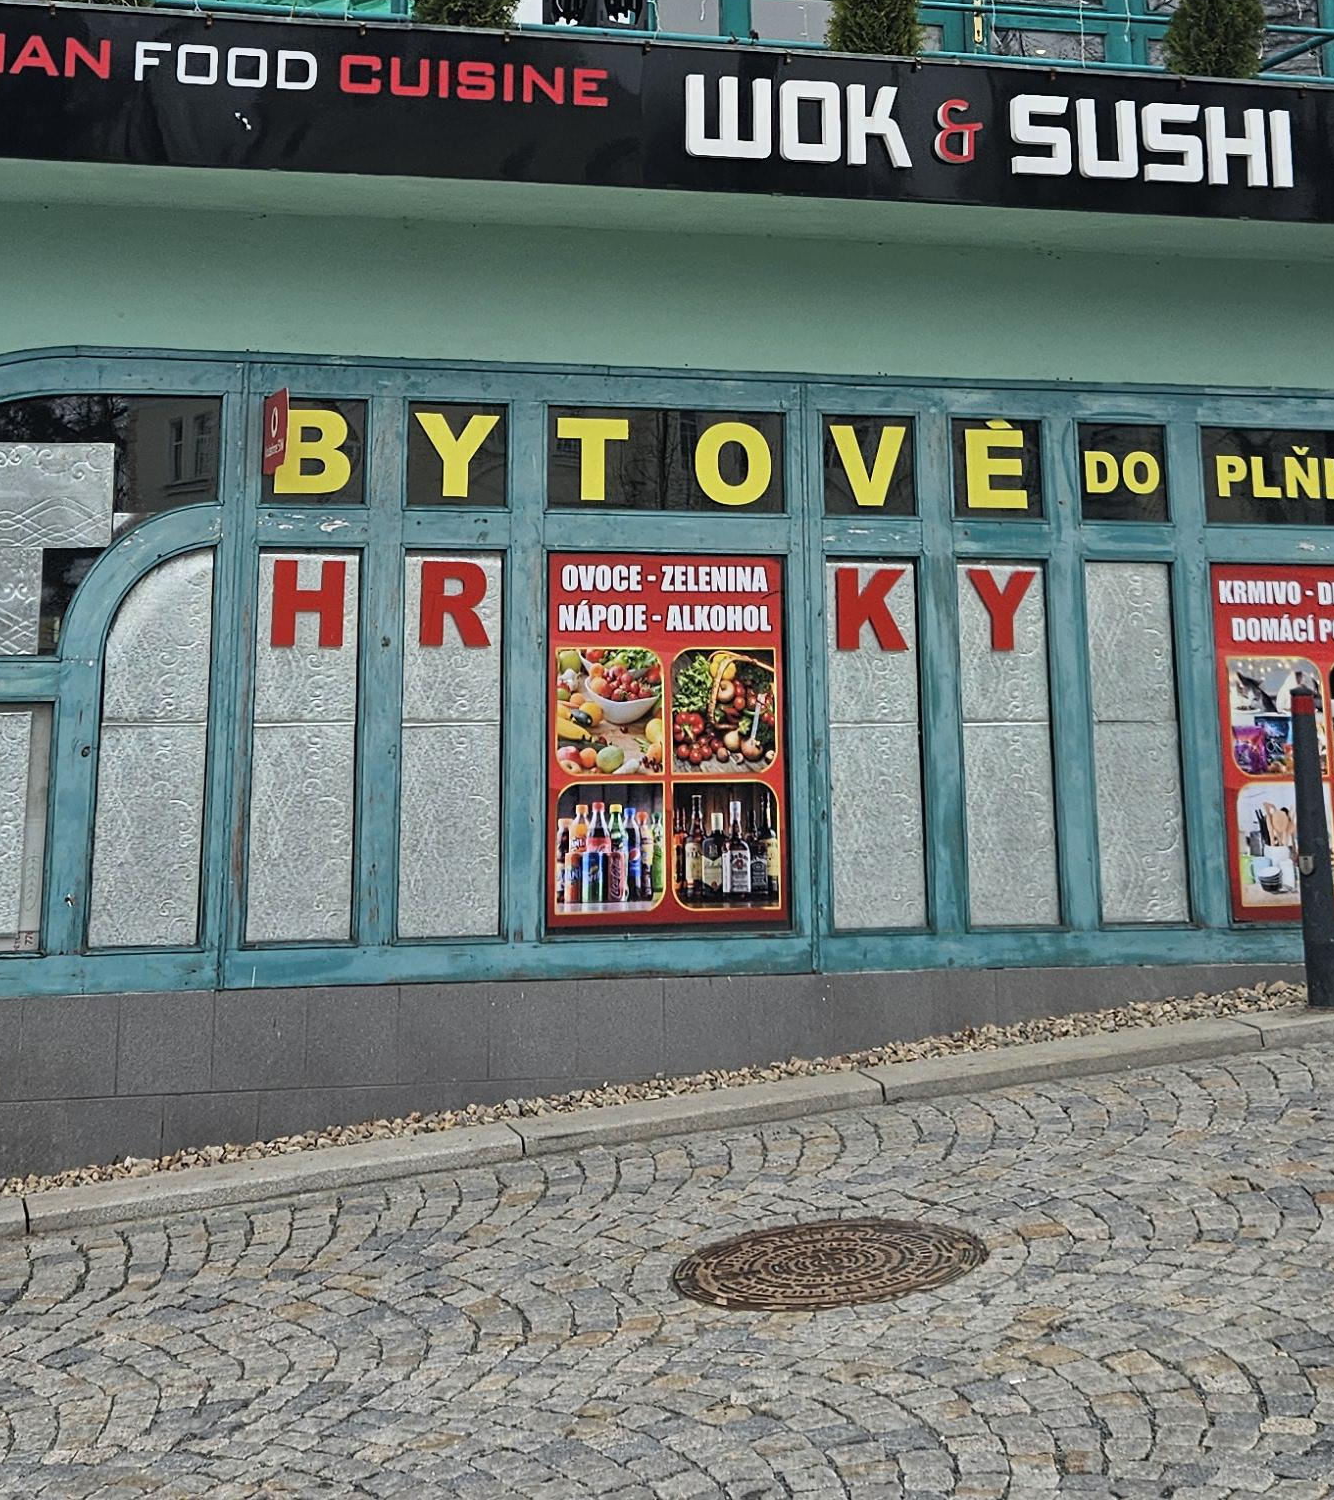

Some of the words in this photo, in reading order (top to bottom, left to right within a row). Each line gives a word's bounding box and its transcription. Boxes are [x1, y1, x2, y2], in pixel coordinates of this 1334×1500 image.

[134, 41, 318, 91] FOOD
[339, 54, 609, 107] CUISINE
[684, 73, 913, 169] WOK
[934, 100, 983, 165] &
[1010, 94, 1295, 189] SUSHI
[1083, 450, 1161, 495] DO
[561, 564, 643, 593] OVOCE
[660, 564, 769, 593] ZELENINA
[1218, 580, 1302, 606] KRMIVO
[558, 600, 648, 632] NÁPOJE
[665, 604, 772, 632] ALKOHOL
[1231, 613, 1316, 642] DOMÁCÍ
